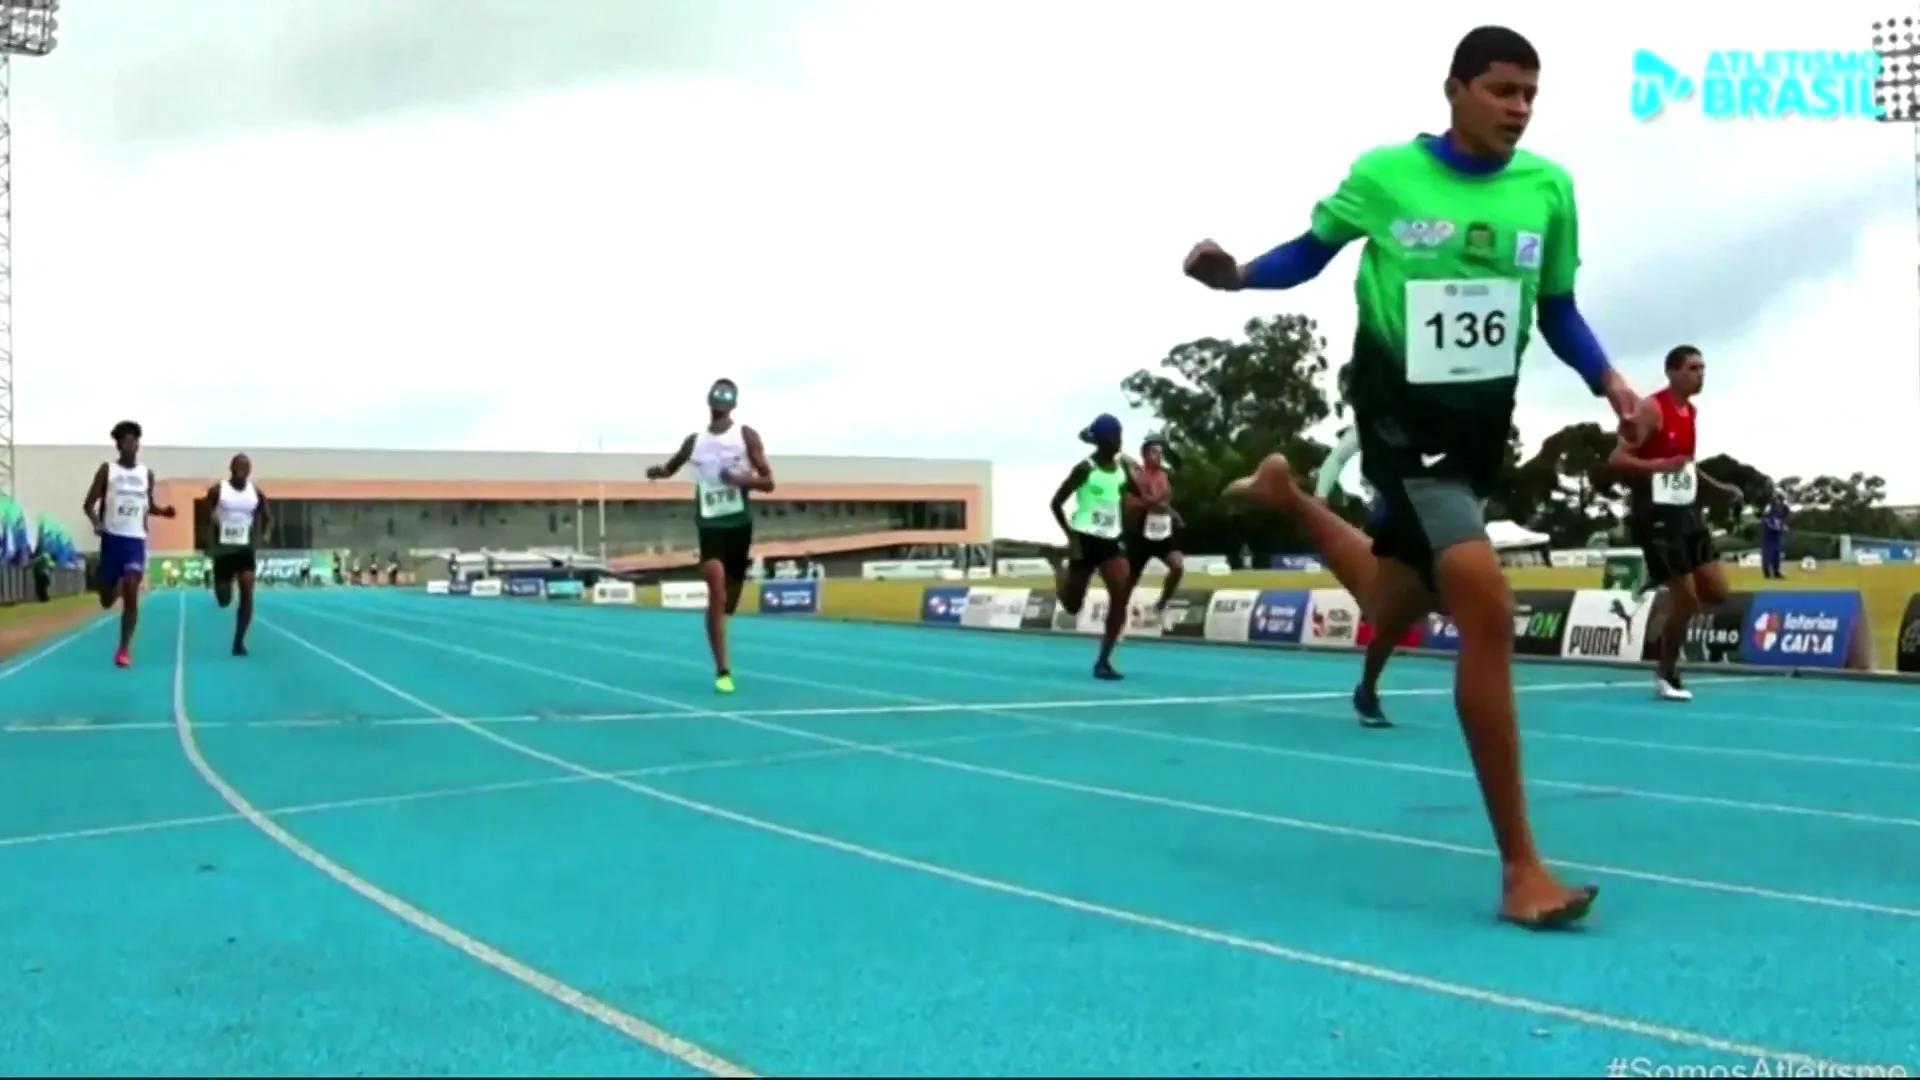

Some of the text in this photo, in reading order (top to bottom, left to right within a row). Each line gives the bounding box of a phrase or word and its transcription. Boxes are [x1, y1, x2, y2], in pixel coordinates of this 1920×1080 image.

[1425, 309, 1506, 350] 136
[1783, 612, 1839, 631] loterias
[1567, 625, 1623, 657] PUMA
[1780, 633, 1835, 655] CAIXA
